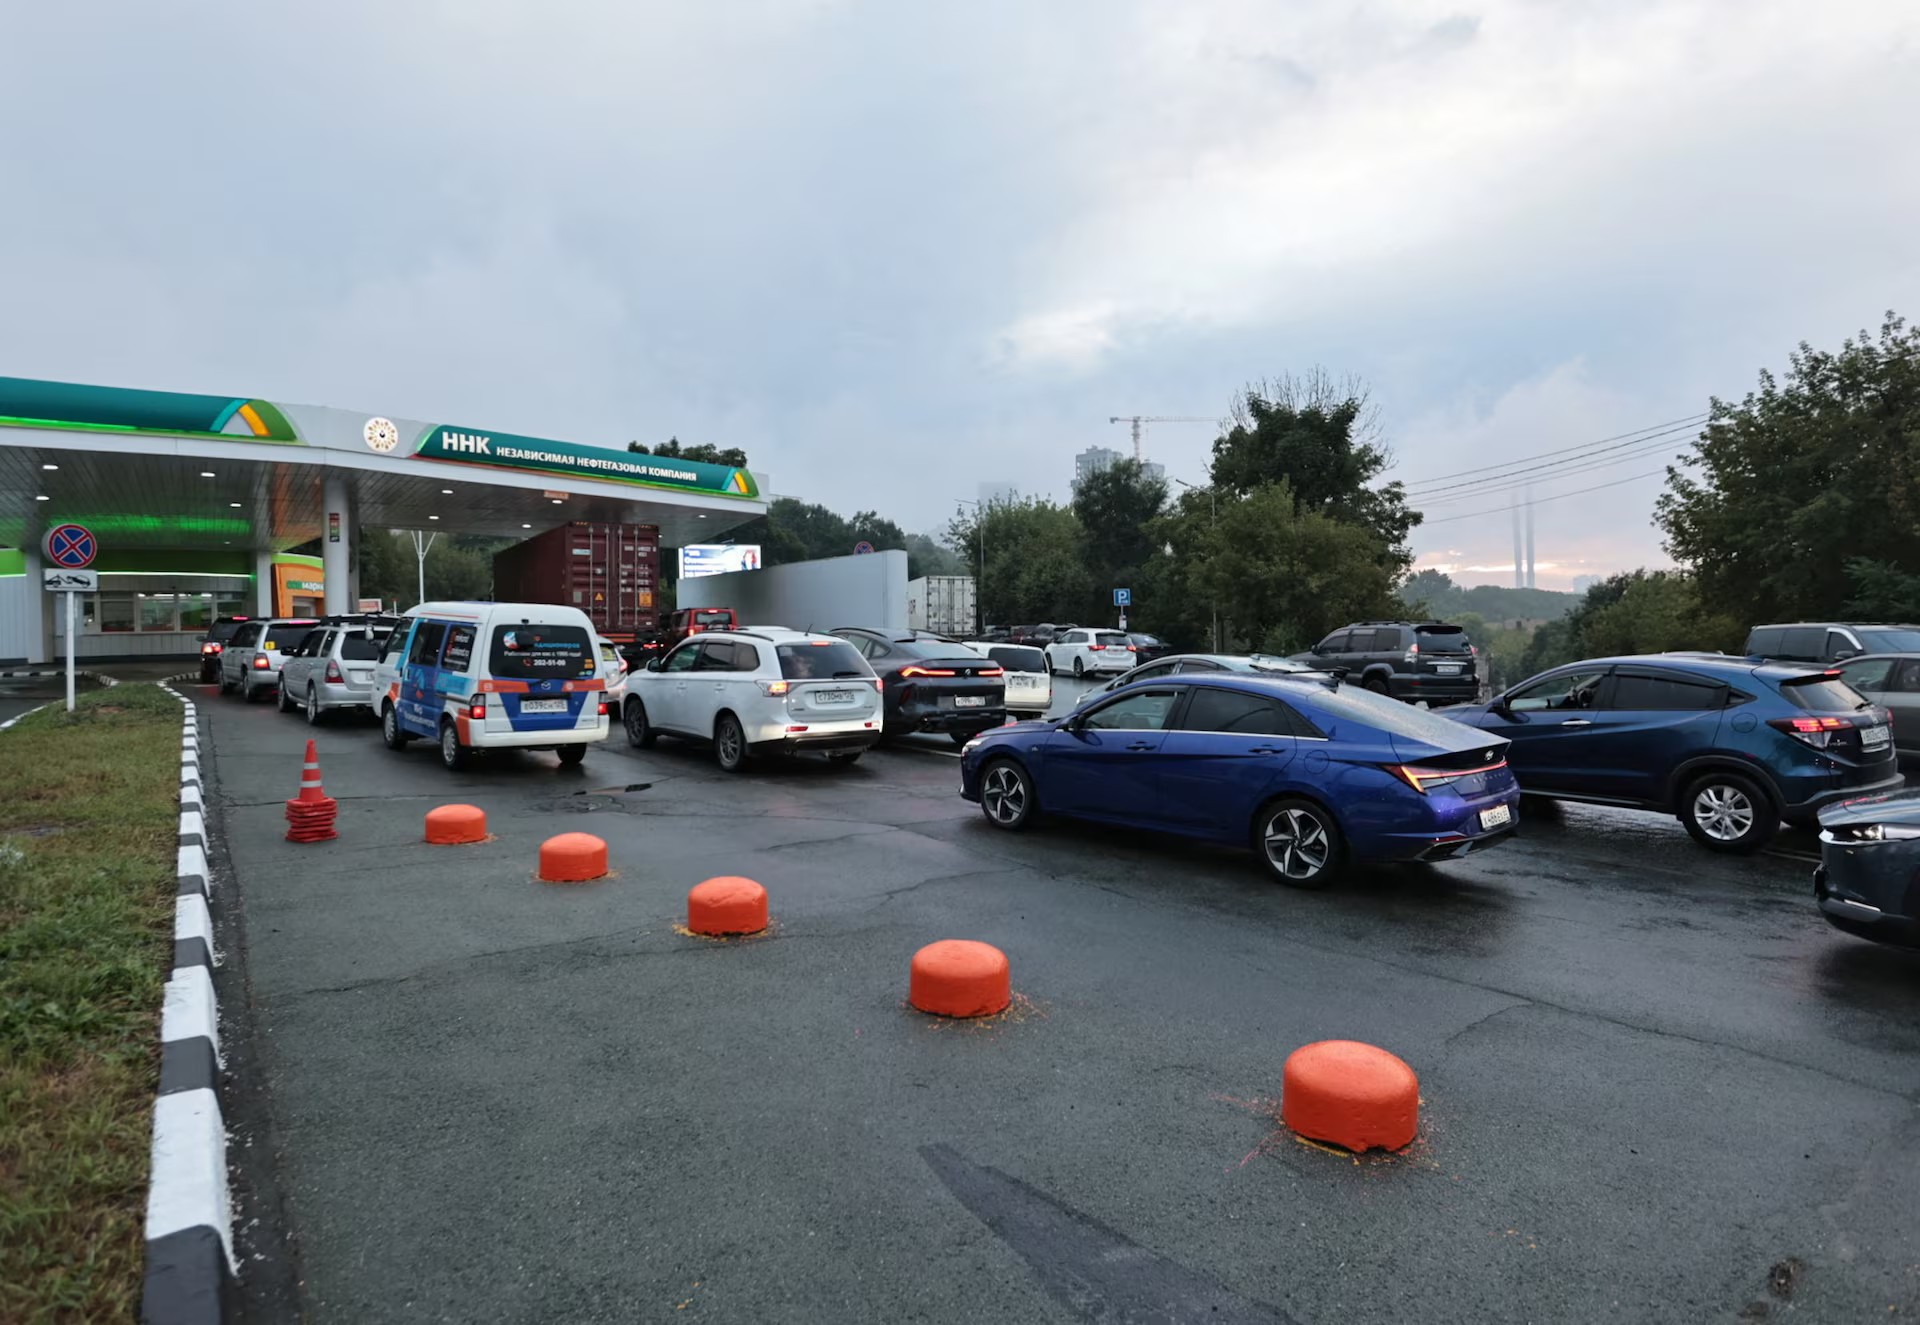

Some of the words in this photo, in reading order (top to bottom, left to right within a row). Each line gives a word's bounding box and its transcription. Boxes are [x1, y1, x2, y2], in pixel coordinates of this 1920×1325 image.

[442, 431, 491, 455] ННК
[496, 446, 575, 465] НЕЗАВИСИМАЯ
[577, 457, 647, 475] НЕФТЕГАЗОВАЯ
[648, 467, 697, 481] КОМПАНИЯ
[1118, 591, 1127, 603] P
